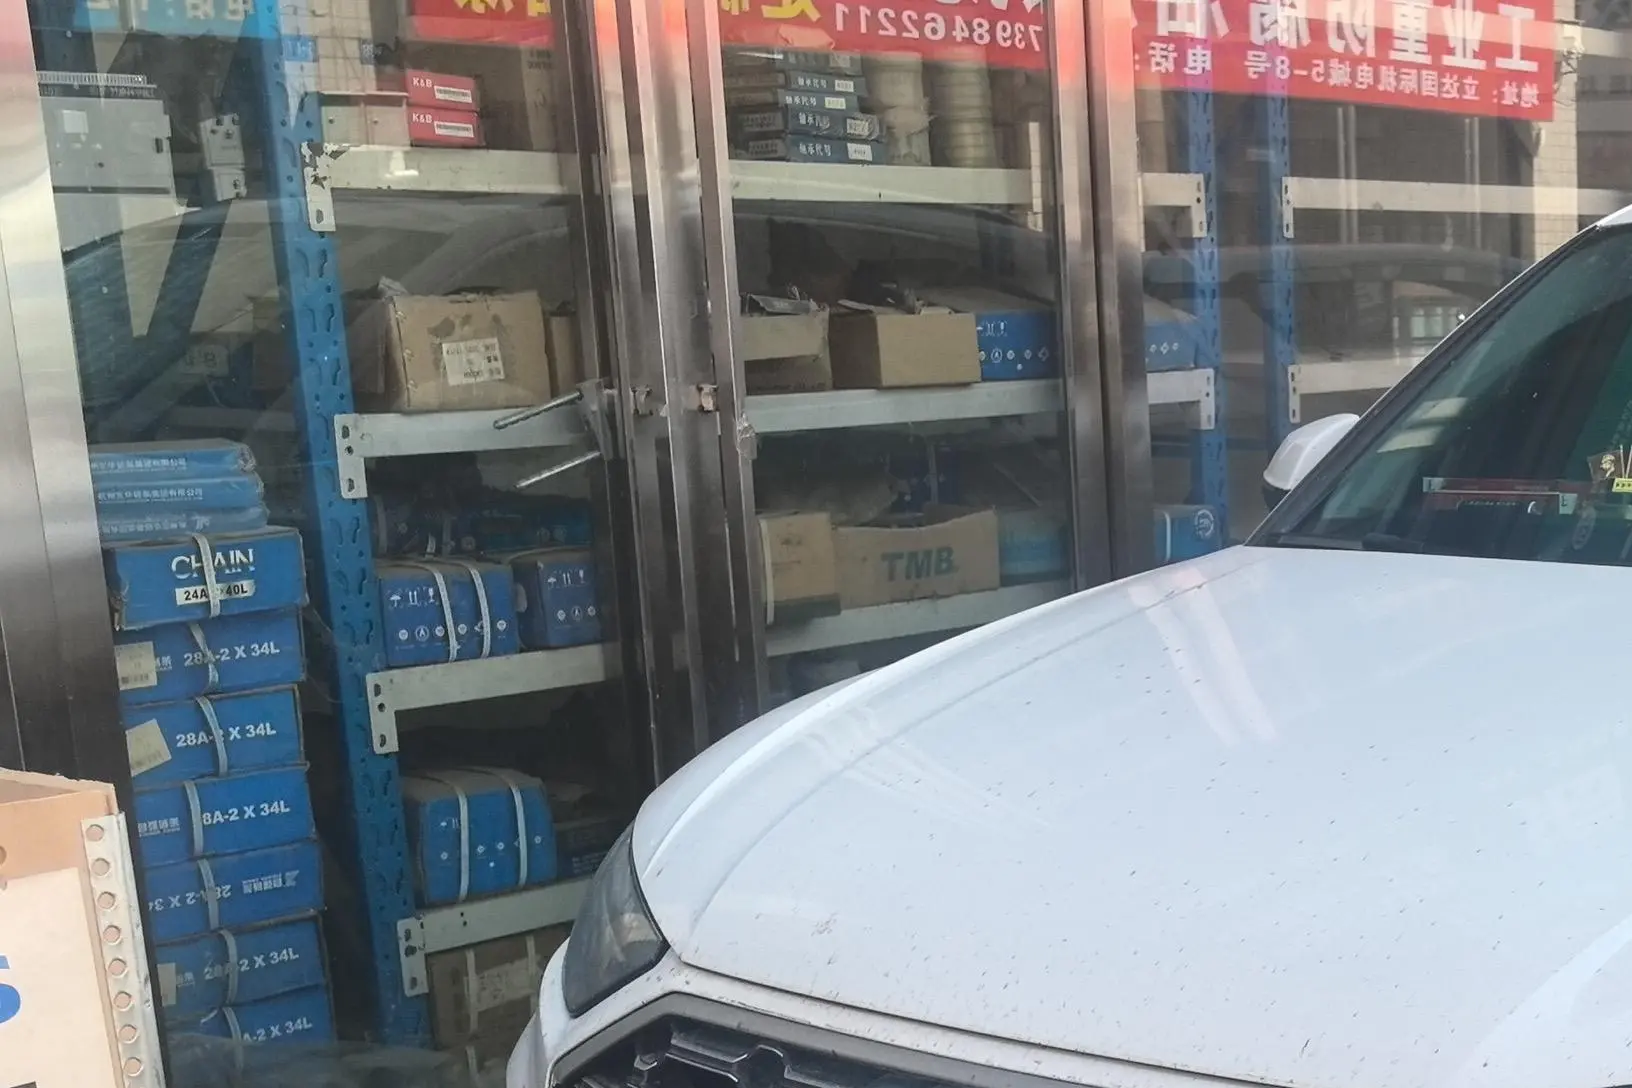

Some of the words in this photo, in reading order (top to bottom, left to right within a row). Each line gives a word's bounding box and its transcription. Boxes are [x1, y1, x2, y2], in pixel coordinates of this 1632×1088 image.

[412, 77, 432, 88] K&B
[412, 112, 432, 123] K&B
[171, 548, 255, 580] CHAIN
[880, 546, 956, 582] TMB
[234, 645, 247, 660] X
[251, 641, 280, 658] 34L
[229, 726, 242, 742] X
[245, 722, 277, 739] 34L
[202, 807, 240, 826] 8A-2
[243, 805, 256, 819] X
[259, 800, 291, 816] 34L
[269, 947, 300, 964] 34L
[285, 1016, 313, 1034] 34L
